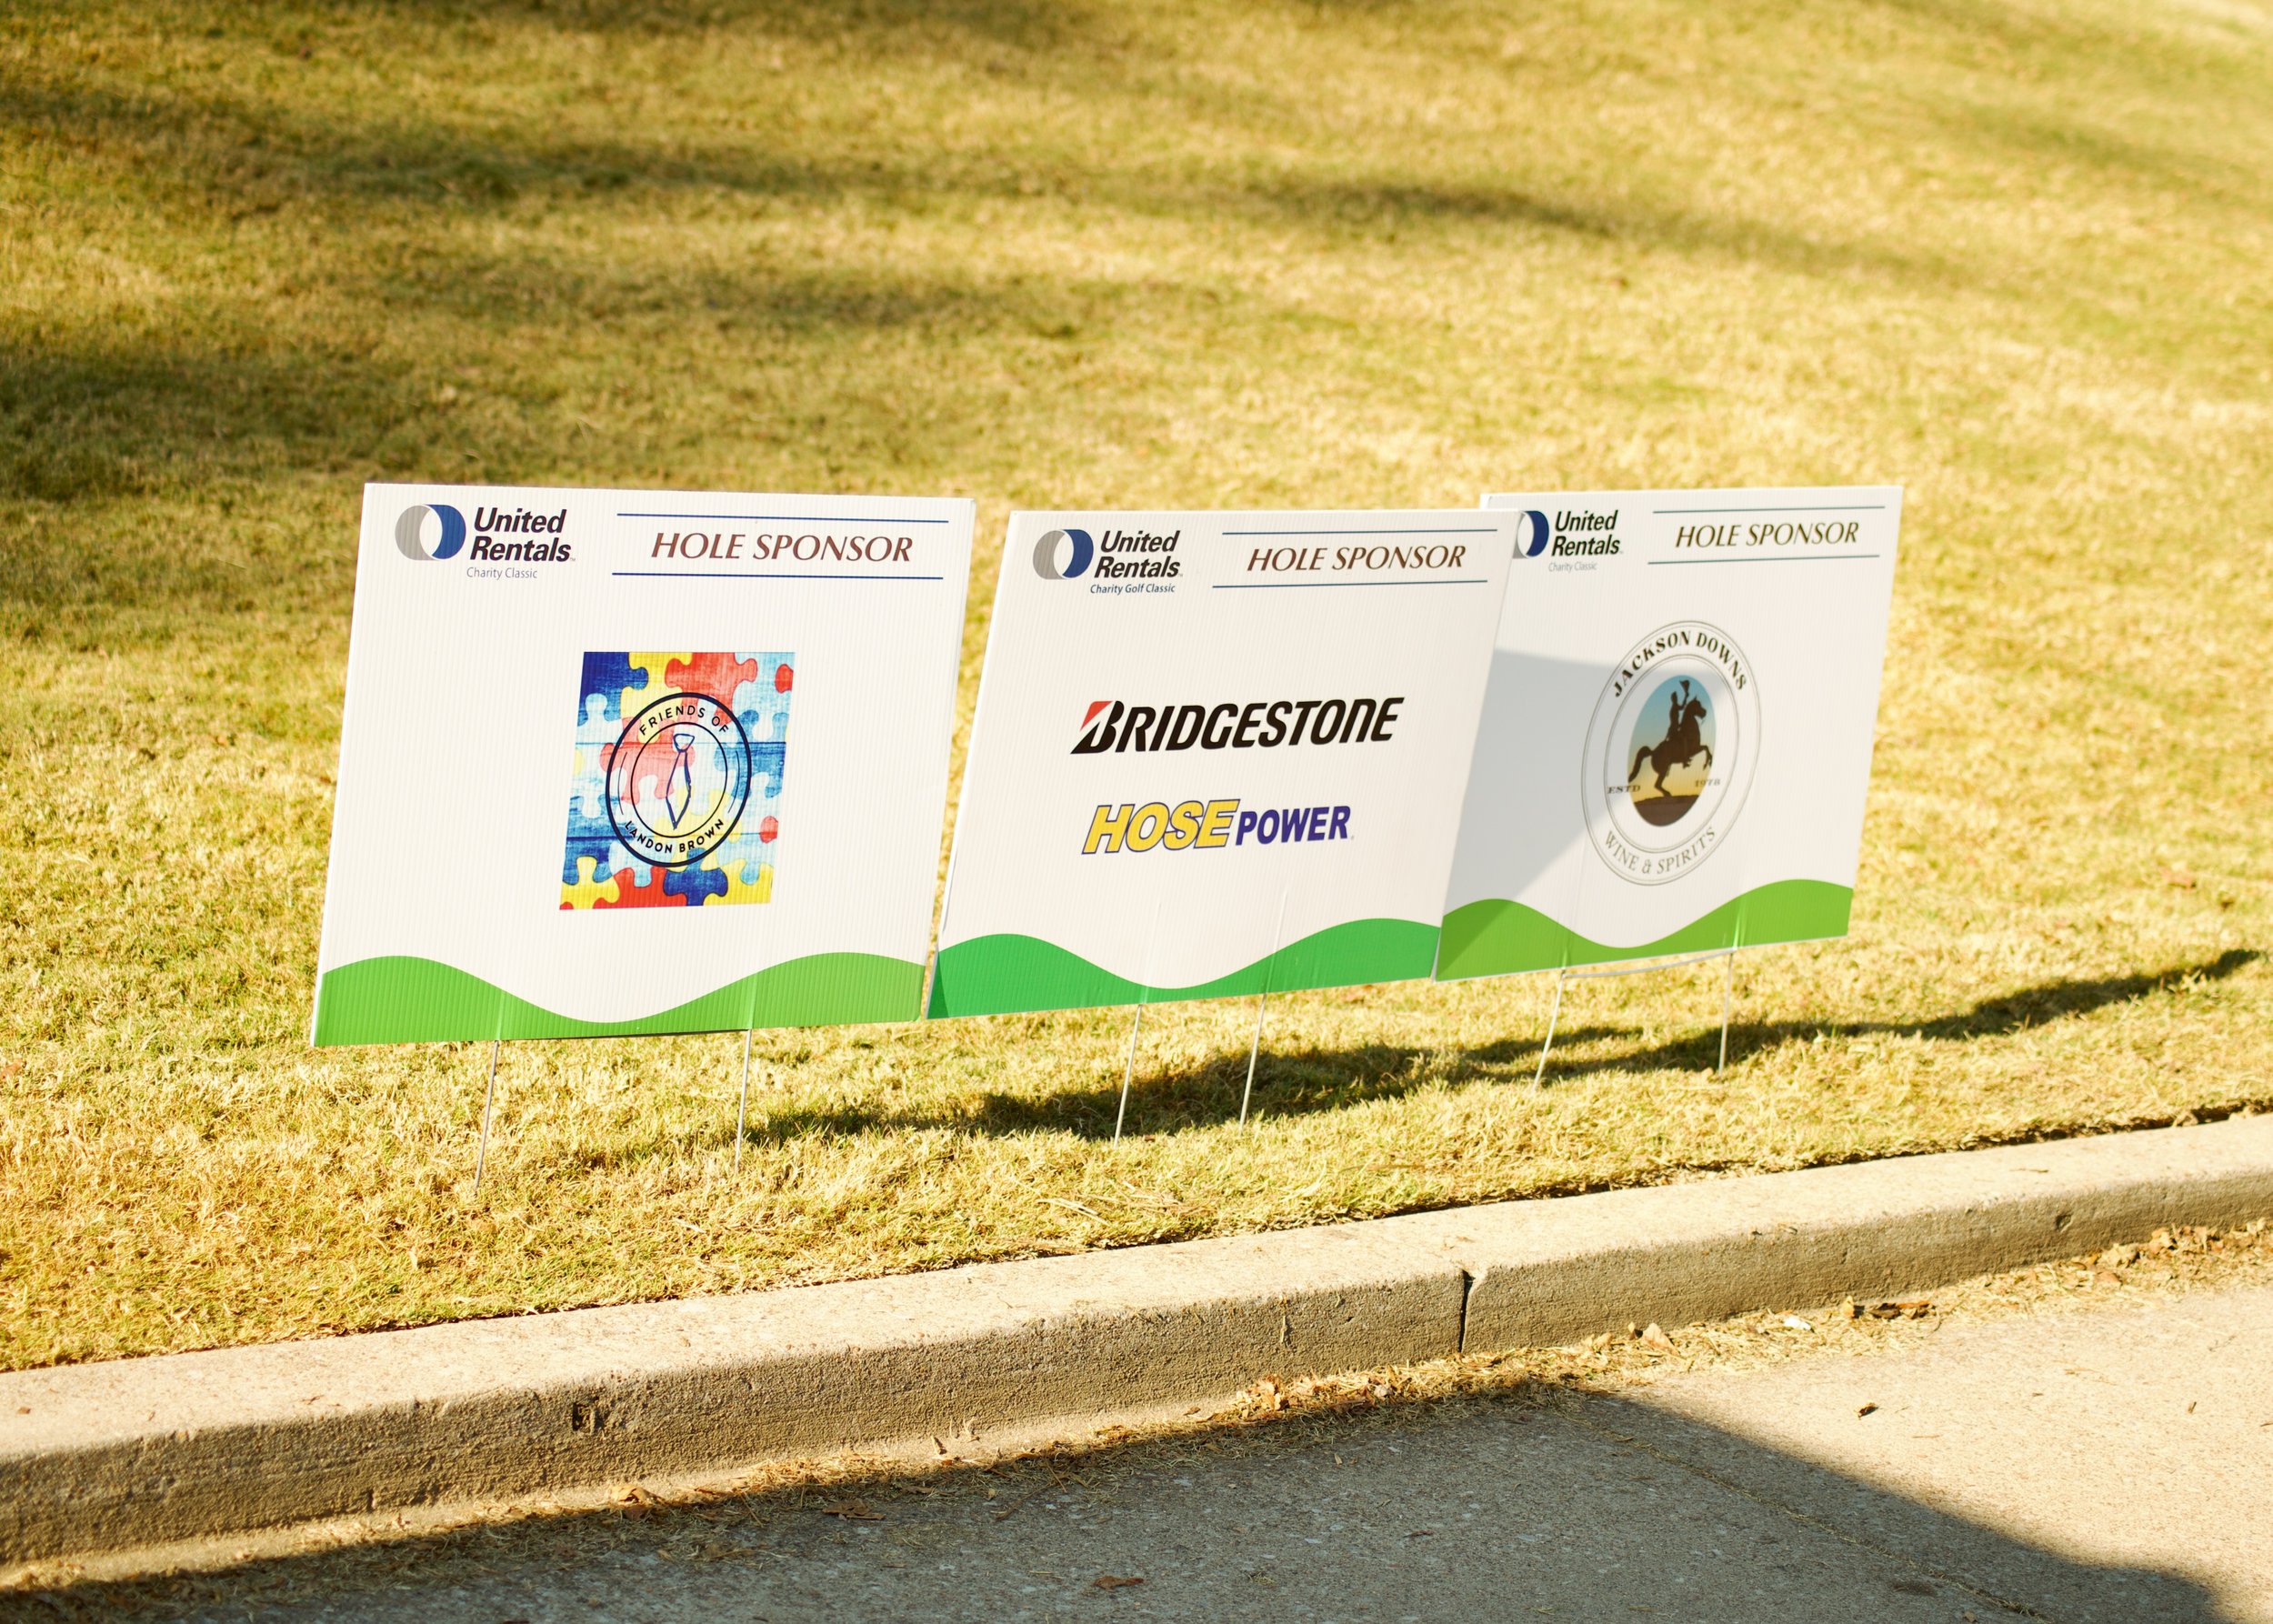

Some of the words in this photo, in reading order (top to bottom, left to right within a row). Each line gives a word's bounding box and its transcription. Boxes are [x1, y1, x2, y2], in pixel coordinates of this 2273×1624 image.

[475, 506, 567, 535] United
[1555, 509, 1618, 532] United
[651, 532, 746, 560] HOLE
[753, 534, 913, 562] SPONSOR
[1100, 530, 1181, 553] United
[1552, 534, 1620, 556] Rentals
[1676, 525, 1741, 548] HOLE
[1746, 522, 1860, 546] SPONSOR
[470, 535, 571, 562] Rentals
[1247, 547, 1327, 571] HOLE
[1331, 545, 1466, 570] SPONSOR
[466, 566, 503, 580] Charity
[505, 566, 537, 578] Classic
[1094, 556, 1180, 579] Rentals
[1548, 562, 1573, 573] Charity
[1574, 561, 1597, 571] Classic
[1090, 584, 1124, 596] Charity
[1125, 583, 1147, 595] Golf
[1147, 584, 1175, 593] Classic
[1613, 630, 1691, 698] JACKSON
[1695, 630, 1747, 692] DOWNS
[639, 705, 705, 736] FRIENDS
[711, 716, 729, 733] OF
[1070, 697, 1406, 755] BRIDGESTONE
[1607, 784, 1641, 795] ESTD
[625, 821, 673, 853] LANDON
[679, 818, 725, 852] BROWN
[1081, 798, 1242, 854] HOSE
[1235, 806, 1351, 846] POWER
[1605, 829, 1640, 873] WINE
[1641, 857, 1653, 875] &
[1657, 827, 1717, 875] SPIRITS
